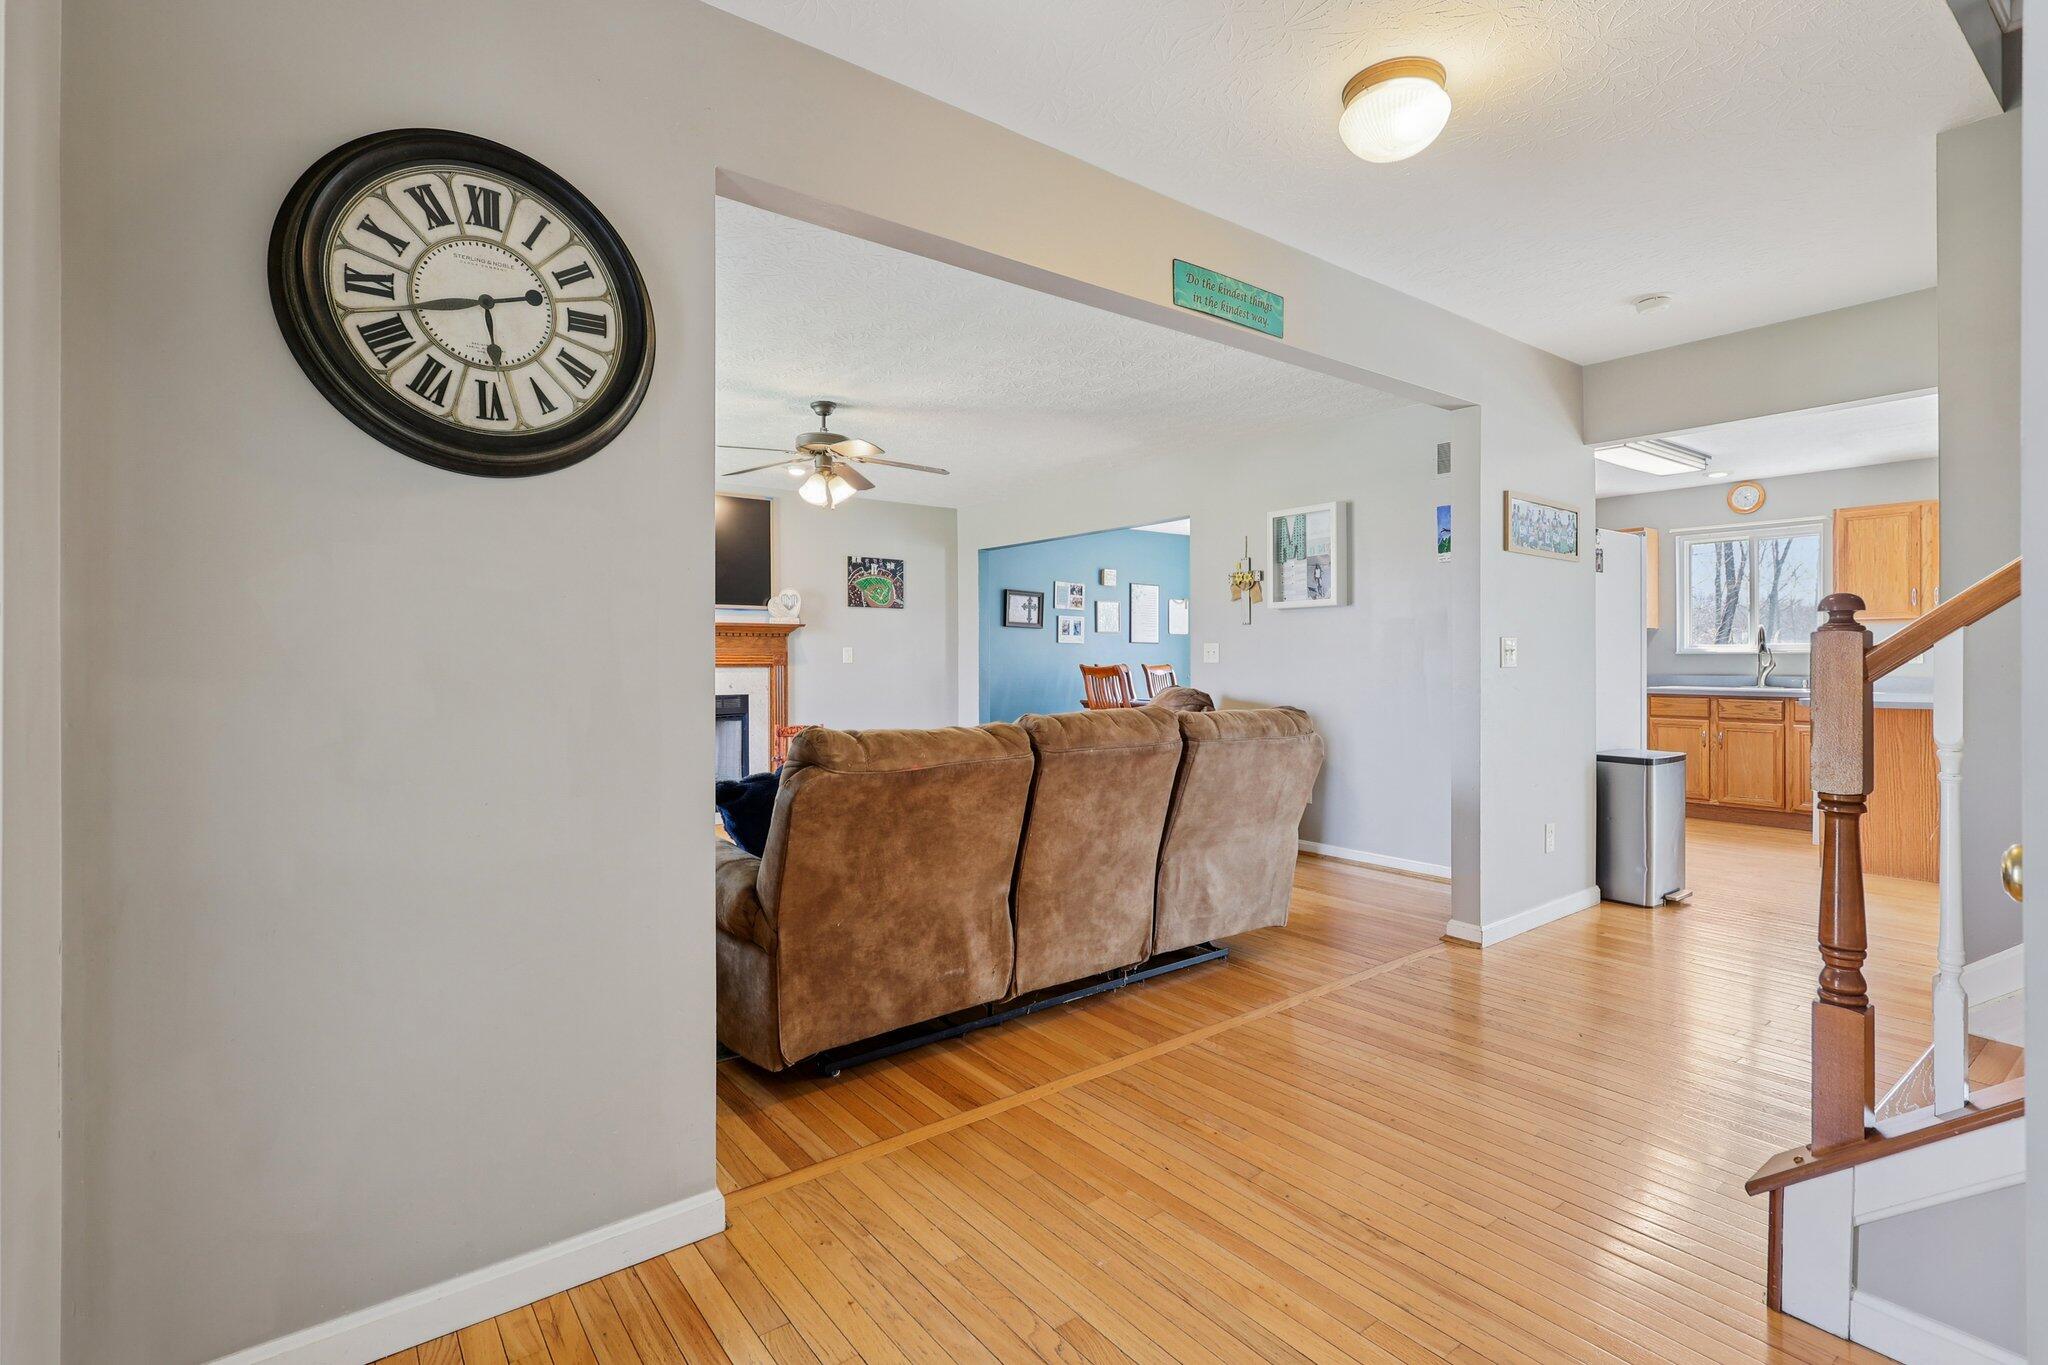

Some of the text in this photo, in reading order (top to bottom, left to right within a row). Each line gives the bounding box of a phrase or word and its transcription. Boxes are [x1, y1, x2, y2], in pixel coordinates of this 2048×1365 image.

[403, 183, 454, 230] XI
[463, 184, 503, 233] XII
[357, 214, 410, 257] X
[522, 215, 551, 250] I
[453, 252, 486, 264] STERLING
[492, 261, 515, 270] NOBLE
[551, 260, 595, 290] II
[343, 263, 395, 301] IX
[1186, 272, 1273, 313] Do the kindest things
[567, 307, 608, 339] III
[1193, 292, 1269, 328] in the kindest way.
[356, 312, 416, 368] VIII
[406, 354, 453, 408] VII
[556, 347, 598, 389] IV
[475, 379, 509, 421] VI
[529, 376, 559, 415] V
